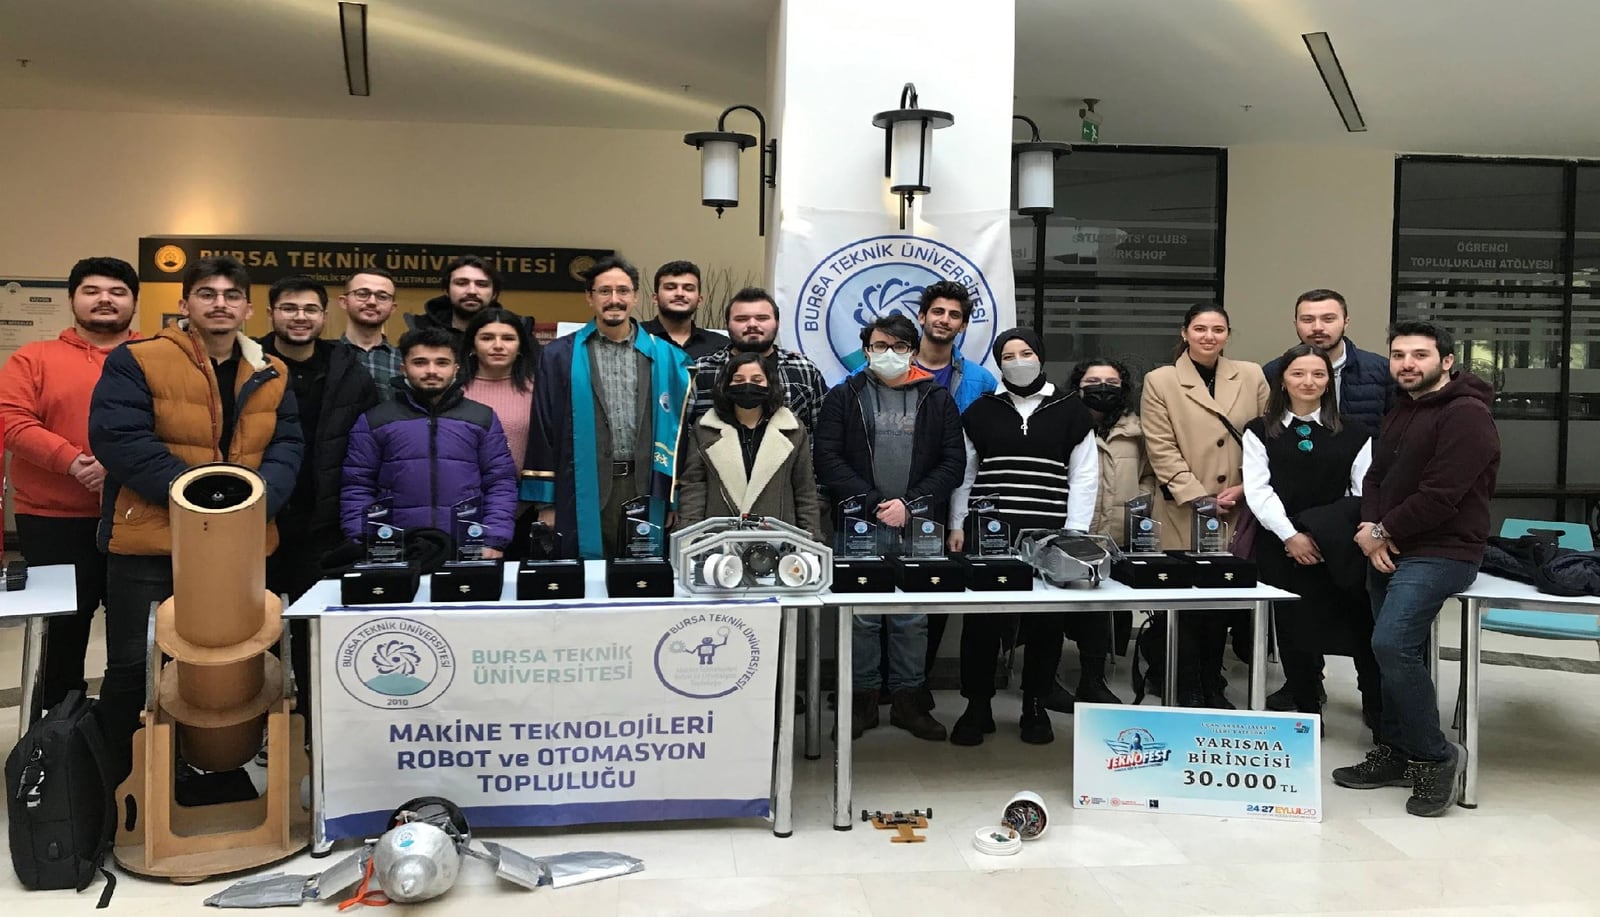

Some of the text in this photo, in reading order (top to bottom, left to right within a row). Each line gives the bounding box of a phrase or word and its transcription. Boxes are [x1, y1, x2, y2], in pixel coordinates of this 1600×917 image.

[1148, 234, 1188, 245] CLUBS
[1457, 241, 1508, 252] ÖĞRENCİ
[288, 247, 377, 269] TEKNİK
[386, 248, 556, 273] ÜNİVİTESİ
[1411, 257, 1553, 270] TOPLULUKLARI ATÖLYESİ
[804, 241, 990, 332] BURSA TEKNİK ÜNİVERSİTESİ
[342, 620, 452, 668] BURSA TEKNİK ÜNİVERSİTESİ
[472, 642, 633, 664] BURSA TEKNİK
[670, 614, 706, 635] BURSA
[709, 613, 747, 630] TEKNİK
[735, 627, 761, 690] ÜNİVERSİTESİ
[473, 661, 633, 685] ÜNİVERSİTESİ
[387, 698, 409, 706] 2010
[389, 710, 714, 743] MAKİNE TEKNOLOJİLERİ
[1195, 737, 1283, 751] YARISMA
[397, 742, 706, 770] ROBOT ve OTOMASYON
[1106, 749, 1172, 770] TEKNOFEST
[1188, 750, 1291, 768] BİRİNCİSİ
[477, 766, 636, 793] TOPLULUĞU
[1183, 770, 1298, 793] 30.000 TL
[1246, 804, 1260, 812] 24
[1261, 805, 1275, 813] 27
